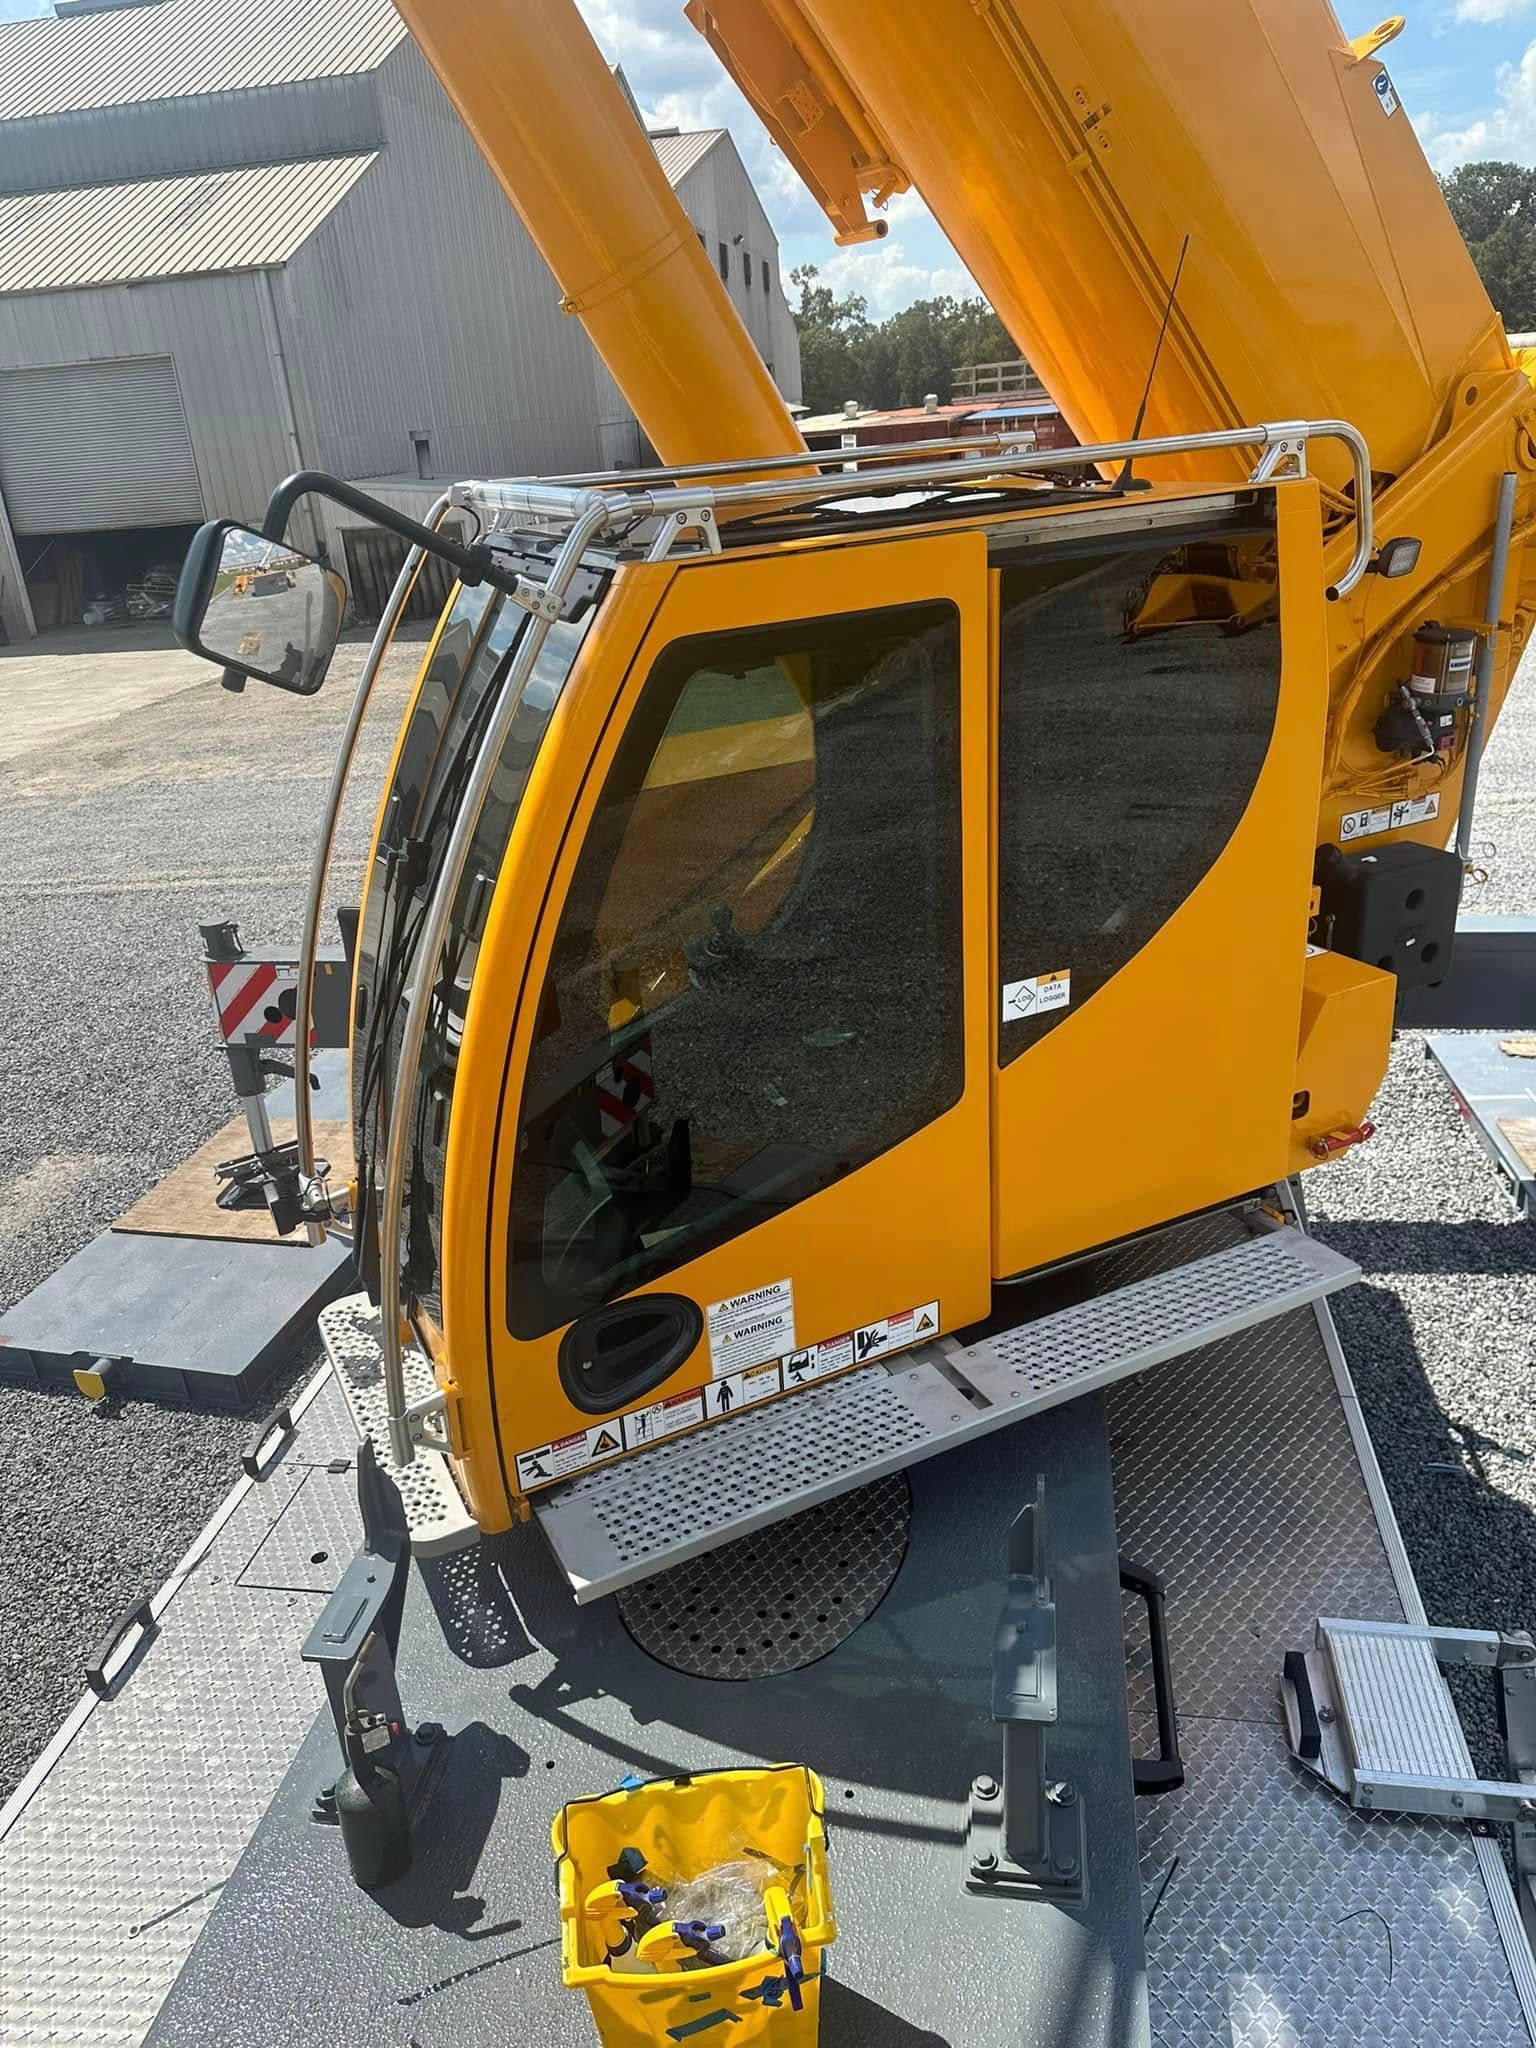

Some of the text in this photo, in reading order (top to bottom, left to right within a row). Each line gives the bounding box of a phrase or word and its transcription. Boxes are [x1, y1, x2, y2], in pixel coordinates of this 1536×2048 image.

[1043, 983, 1061, 992] DATA
[1018, 994, 1032, 1003] LOG
[1040, 992, 1066, 1004] LOGGER
[730, 1285, 780, 1308] WARNING
[734, 1316, 782, 1339] WARNING
[750, 1363, 778, 1376] CAUTION
